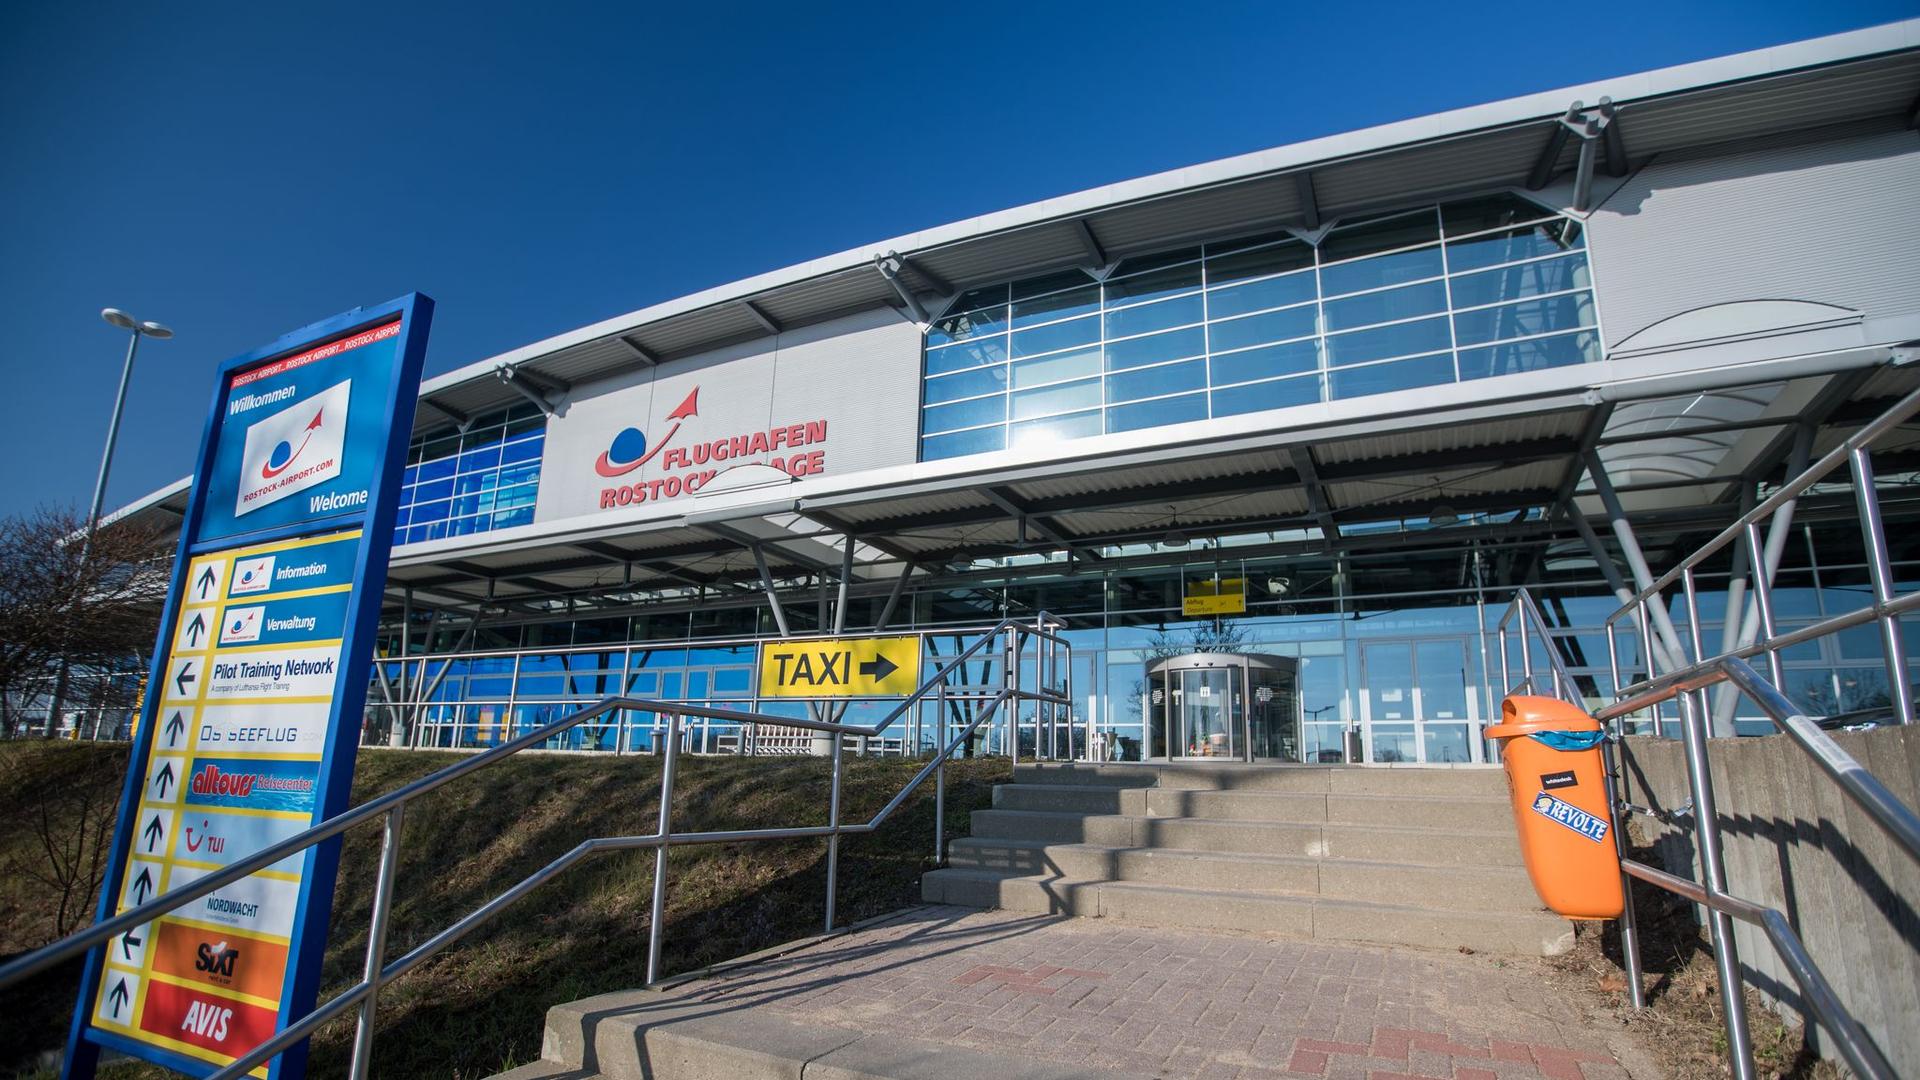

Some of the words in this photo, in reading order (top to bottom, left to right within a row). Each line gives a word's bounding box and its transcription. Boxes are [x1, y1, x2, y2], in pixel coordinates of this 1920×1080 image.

[233, 372, 257, 387] ROSTOCK
[286, 355, 312, 369] ROSTOCK
[345, 333, 374, 350] ROSTOCK
[229, 384, 296, 416] Willkommen
[662, 420, 828, 471] FLUGHAFEN
[243, 458, 334, 503] ROSTOCK-AIRPORT.COM
[310, 488, 368, 514] Welcome
[276, 562, 327, 581] Information
[267, 615, 316, 632] Verwaltung
[213, 662, 238, 680] Pilot
[240, 660, 282, 681] Training
[285, 657, 335, 676] Network
[773, 651, 851, 687] TAXI
[192, 764, 257, 797] alltours
[256, 774, 313, 792] Reisecenter
[1550, 801, 1607, 839] REVOLTE
[207, 836, 225, 854] TUI
[206, 897, 259, 918] NORDWACHT
[181, 1000, 233, 1042] AVIS
